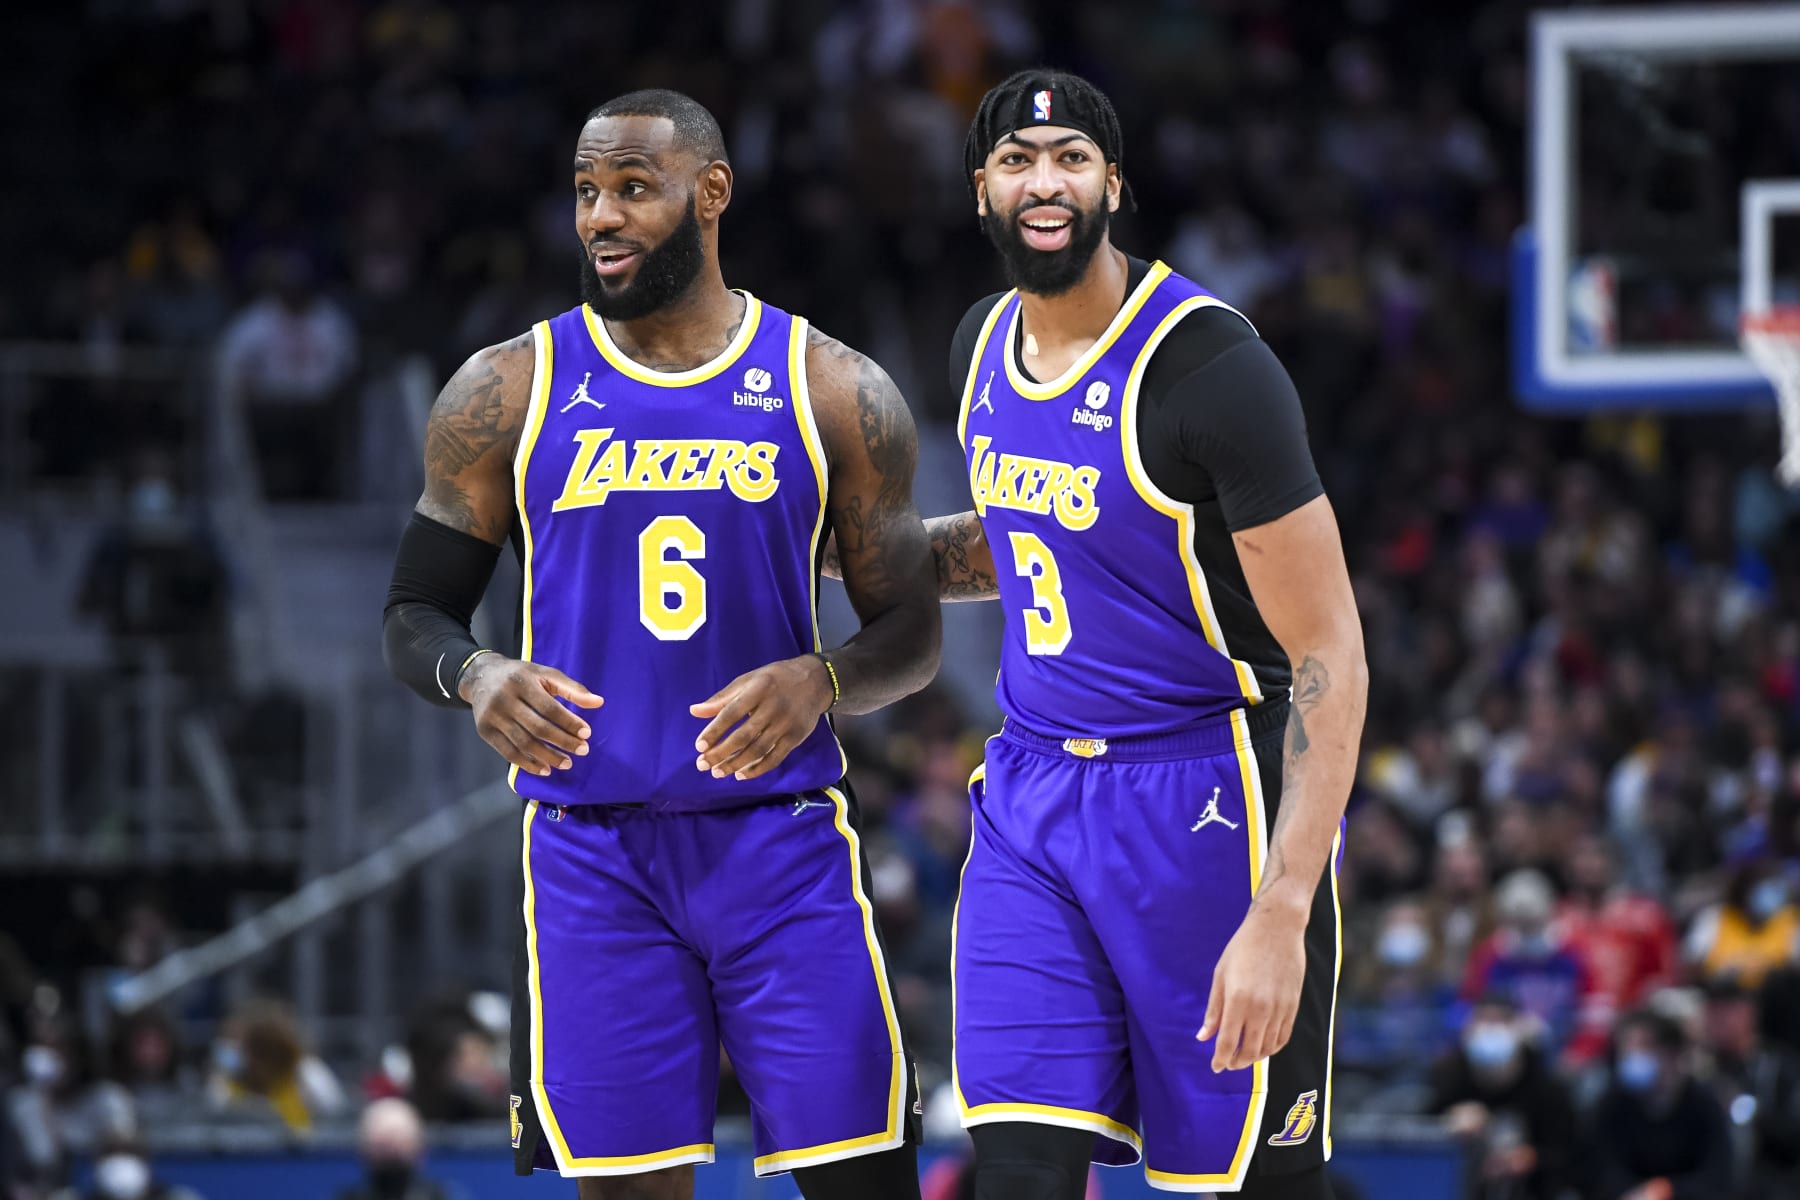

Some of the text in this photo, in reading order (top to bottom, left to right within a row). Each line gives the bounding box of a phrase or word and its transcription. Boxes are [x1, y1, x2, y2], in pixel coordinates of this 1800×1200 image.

[733, 391, 783, 411] bibigo
[1071, 407, 1113, 432] bibigo
[551, 427, 781, 513] LAKERS
[638, 515, 707, 641] 6
[1008, 531, 1072, 656] 3
